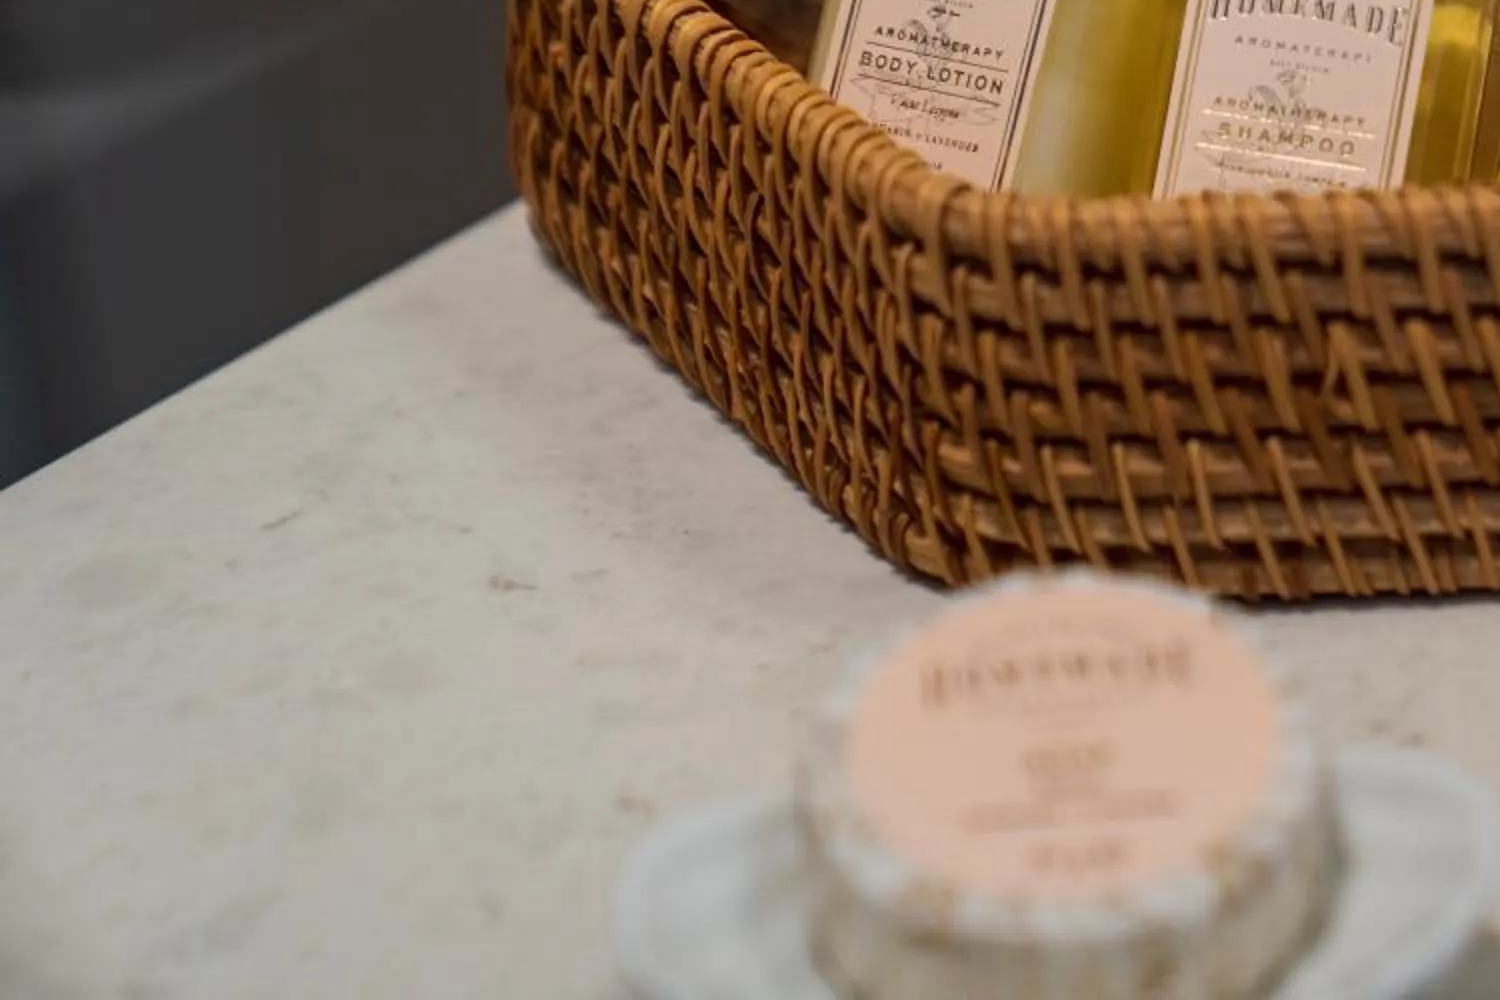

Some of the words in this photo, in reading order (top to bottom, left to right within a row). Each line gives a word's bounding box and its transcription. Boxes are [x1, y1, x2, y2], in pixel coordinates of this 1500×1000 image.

[874, 25, 1004, 60] AROMATHERAPY
[858, 51, 918, 75] BODY
[926, 64, 1004, 95] LOTION
[1218, 122, 1355, 156] SHAMPOO
